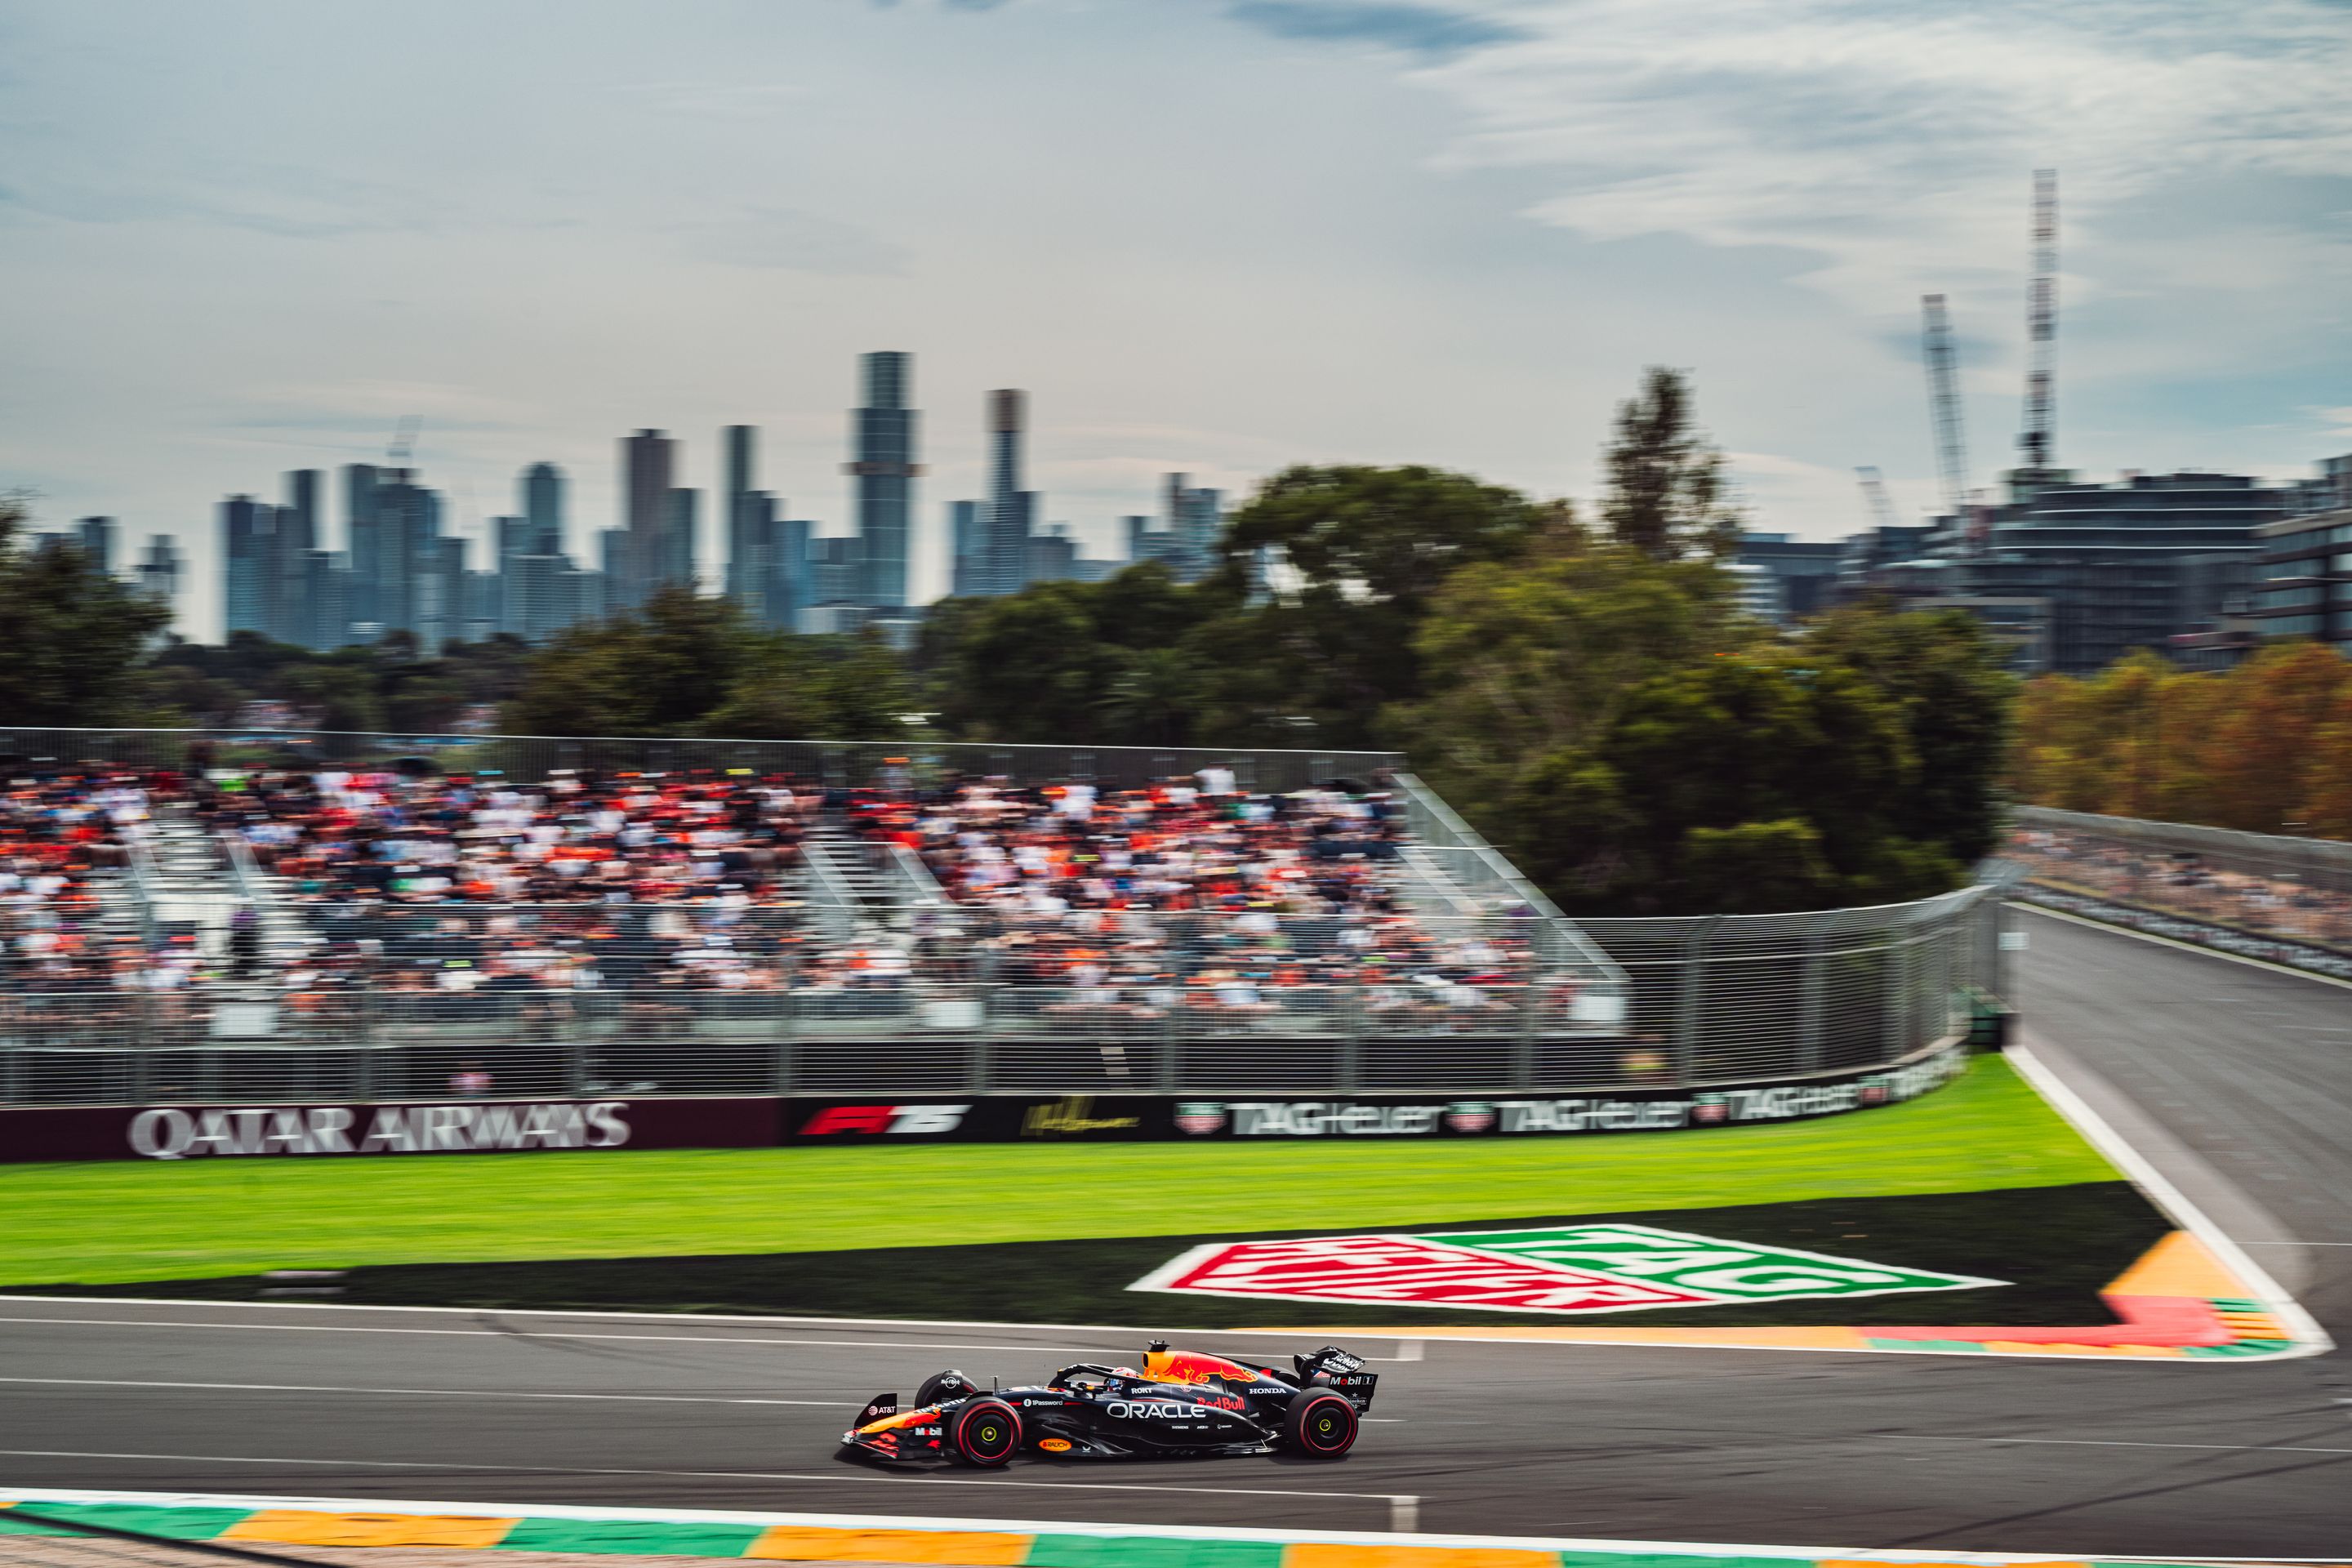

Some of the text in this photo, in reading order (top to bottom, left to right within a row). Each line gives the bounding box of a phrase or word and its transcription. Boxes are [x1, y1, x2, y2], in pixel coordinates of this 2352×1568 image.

[127, 1102, 631, 1160] QATAR AIRWAYS
[1190, 1241, 1679, 1307] HEUER
[1473, 1232, 1908, 1293] TAG
[1330, 1376, 1361, 1386] Mobil
[878, 1405, 896, 1414] AT&T
[1107, 1402, 1207, 1419] ORACLE
